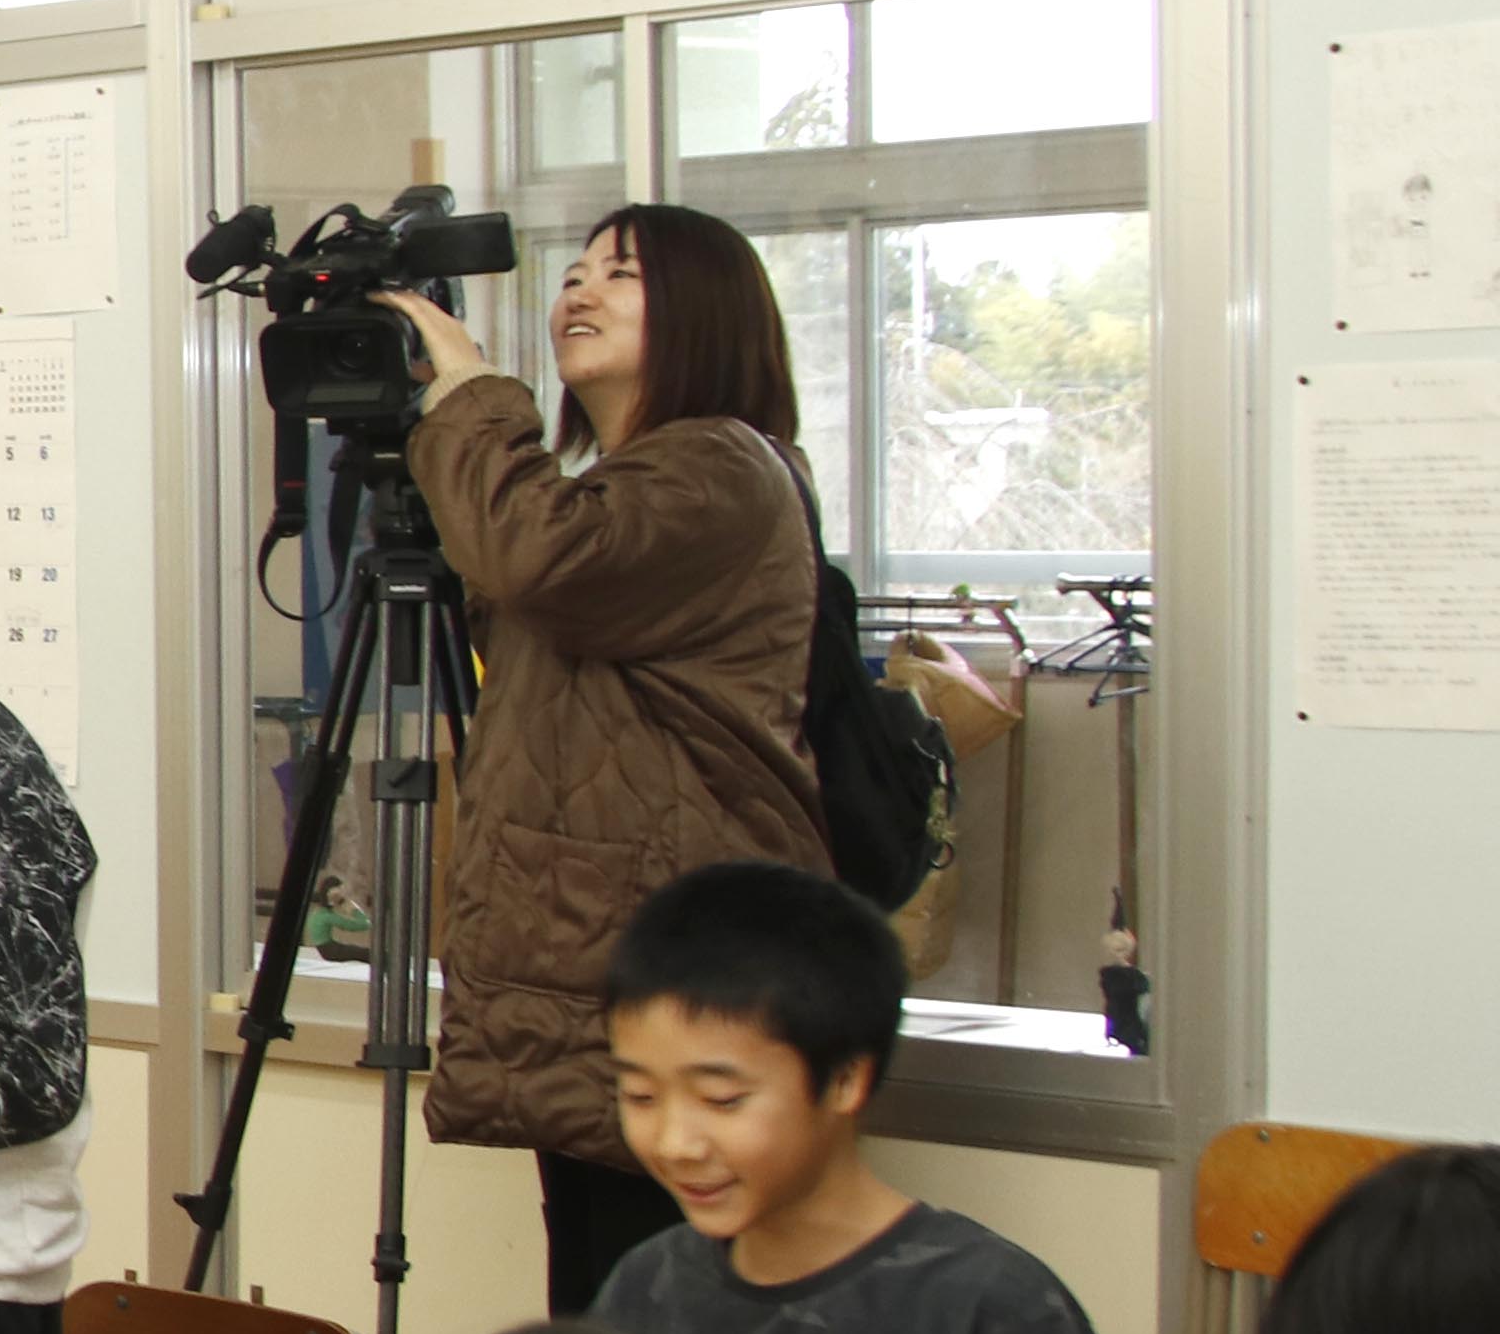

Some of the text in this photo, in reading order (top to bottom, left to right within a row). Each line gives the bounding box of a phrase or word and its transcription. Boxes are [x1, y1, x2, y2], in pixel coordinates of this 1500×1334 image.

[7, 507, 21, 522] 12
[41, 507, 55, 522] 13
[8, 567, 22, 582] 19
[8, 628, 24, 642] 26
